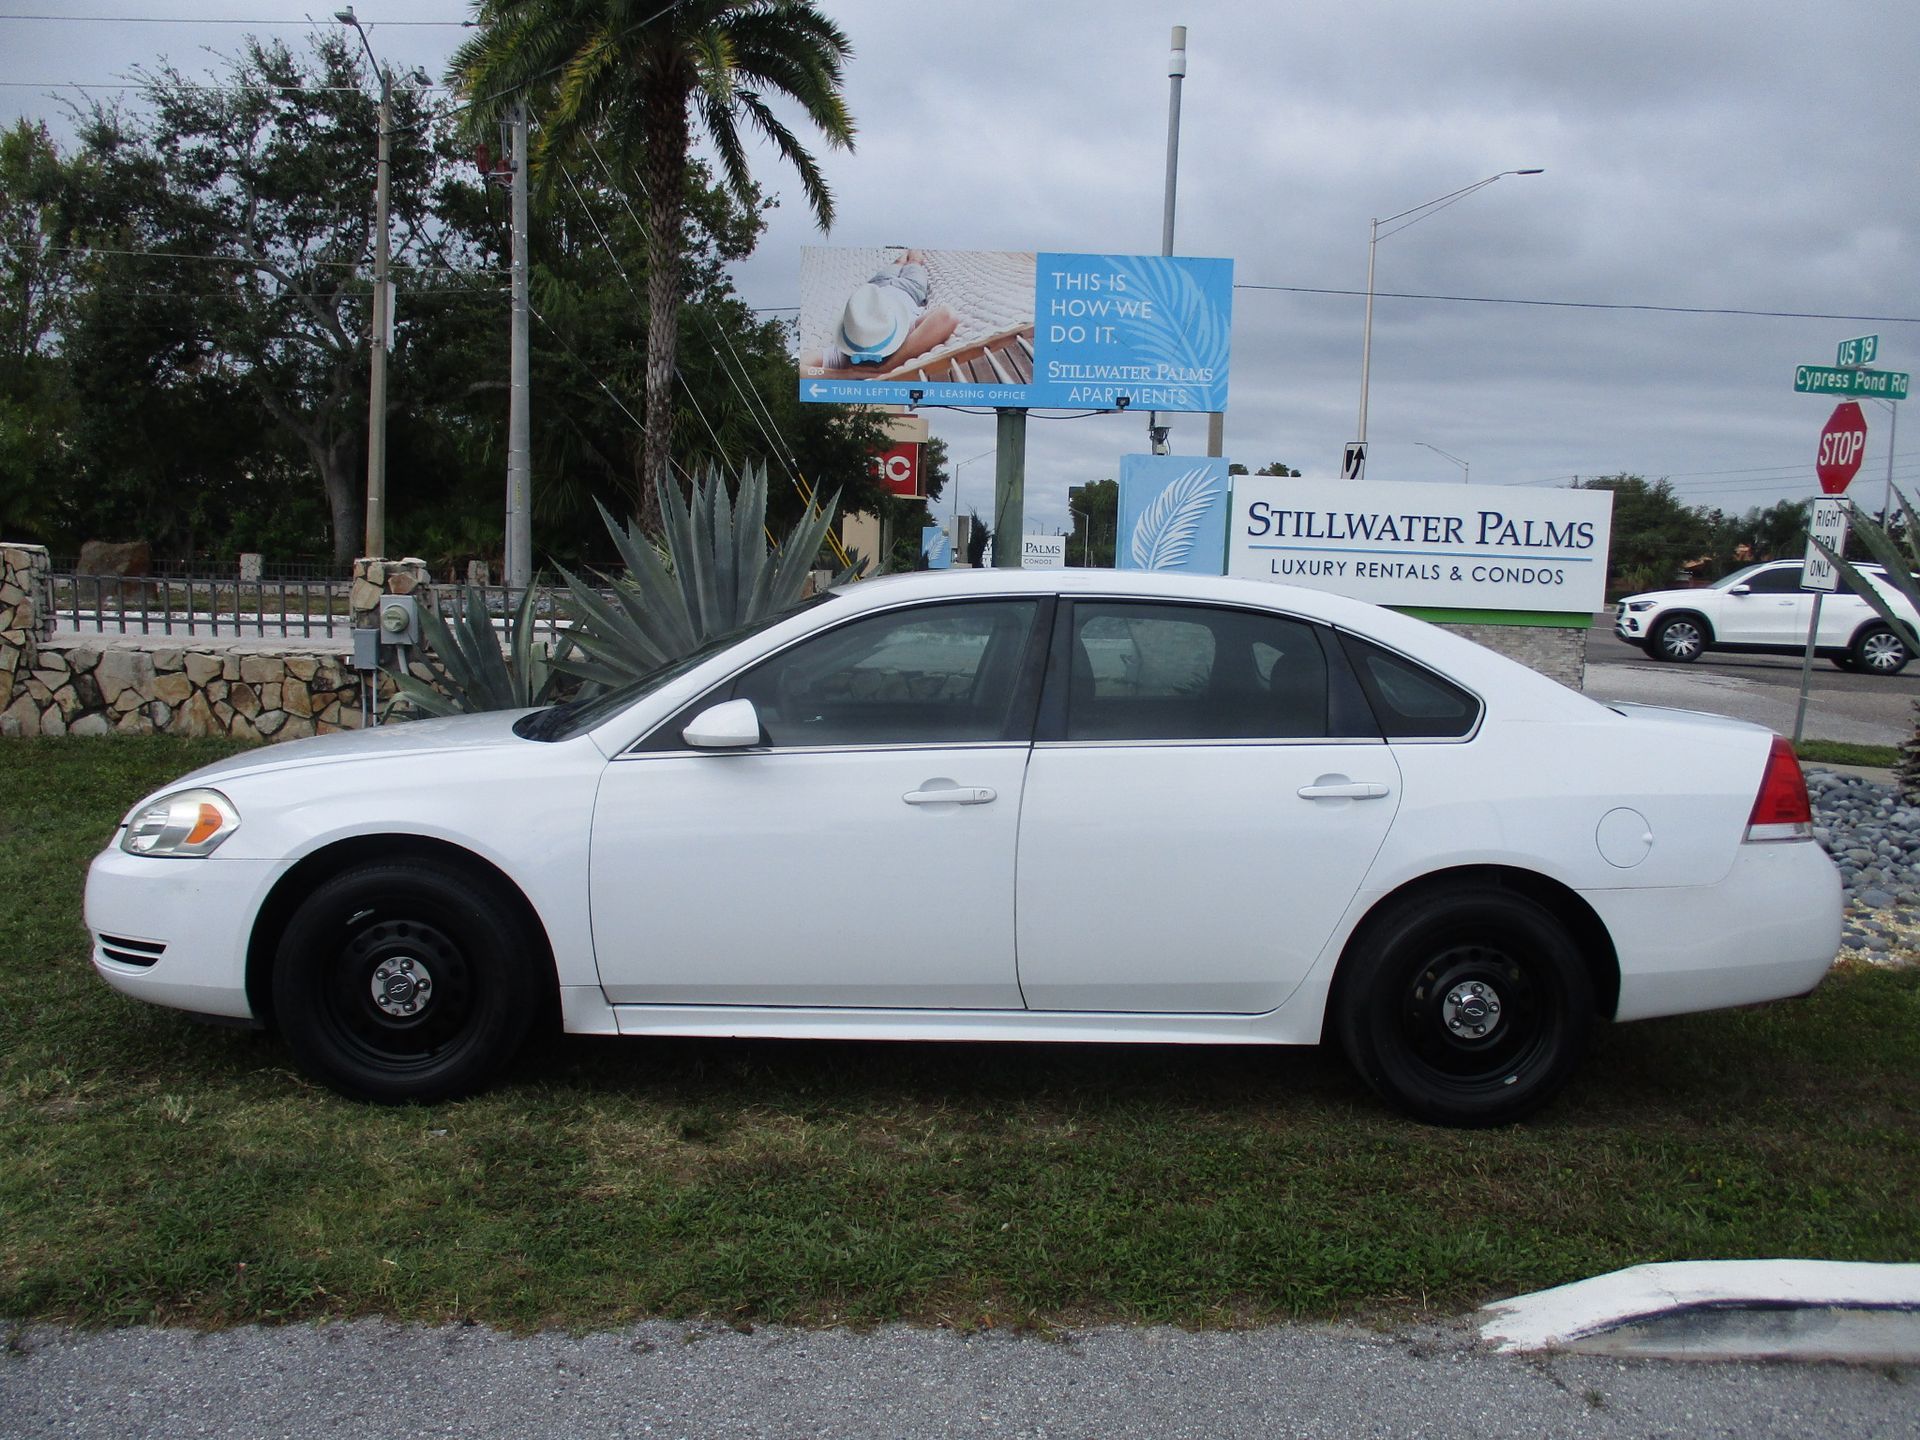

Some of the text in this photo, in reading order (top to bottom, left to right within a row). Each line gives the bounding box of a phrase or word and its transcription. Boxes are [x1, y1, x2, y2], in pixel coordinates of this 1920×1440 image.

[1051, 272, 1127, 292] THIS IS
[1051, 299, 1153, 319] HOW WE
[1050, 325, 1118, 345] DO IT.
[1840, 338, 1875, 366] US 19
[1048, 361, 1214, 383] STILLWATER PALMS
[1796, 366, 1908, 393] Cypress Pond Rd
[832, 386, 862, 396] TURN
[866, 387, 890, 397] LEFT
[894, 388, 909, 397] TO
[940, 389, 985, 400] LEASING
[989, 390, 1026, 401] OFFICE
[1068, 386, 1188, 405] APARTMENTS
[1819, 430, 1864, 467] STOP
[1247, 501, 1595, 550] STILLWATER PALMS
[1816, 510, 1843, 527] RIGHT
[1025, 542, 1061, 555] PALMS
[1271, 558, 1565, 586] LUXURY RENTALS & CONDOS
[1810, 559, 1831, 578] ONLY
